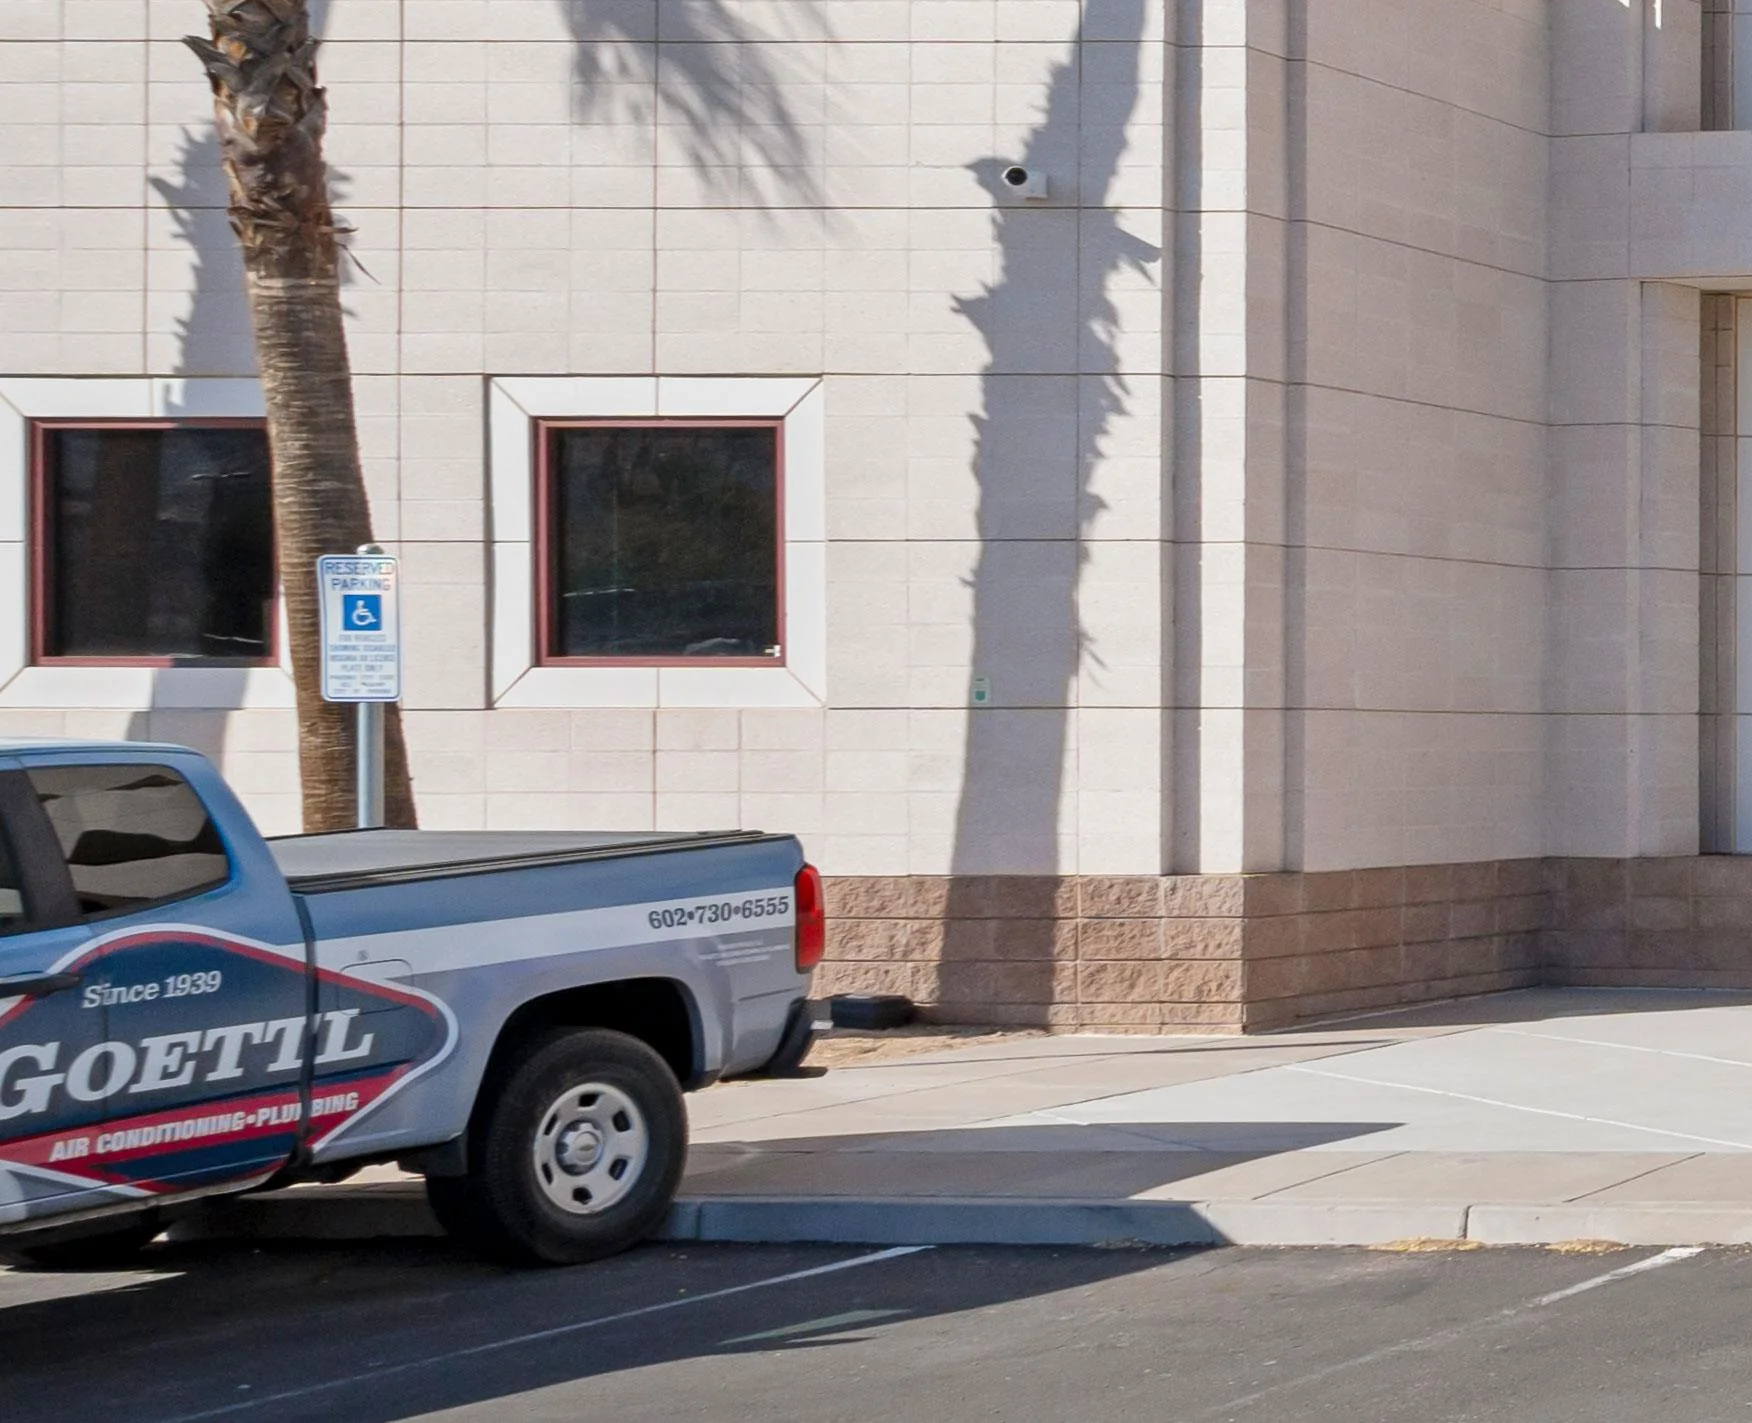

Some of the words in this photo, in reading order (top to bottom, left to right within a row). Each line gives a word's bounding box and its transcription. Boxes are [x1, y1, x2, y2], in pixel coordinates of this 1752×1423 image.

[325, 562, 394, 575] RESERVED
[332, 578, 391, 591] PARKING
[82, 980, 160, 1008] Since
[163, 970, 222, 998] 1939
[50, 1138, 89, 1162] AIR
[97, 1111, 245, 1154] CONDITIONING
